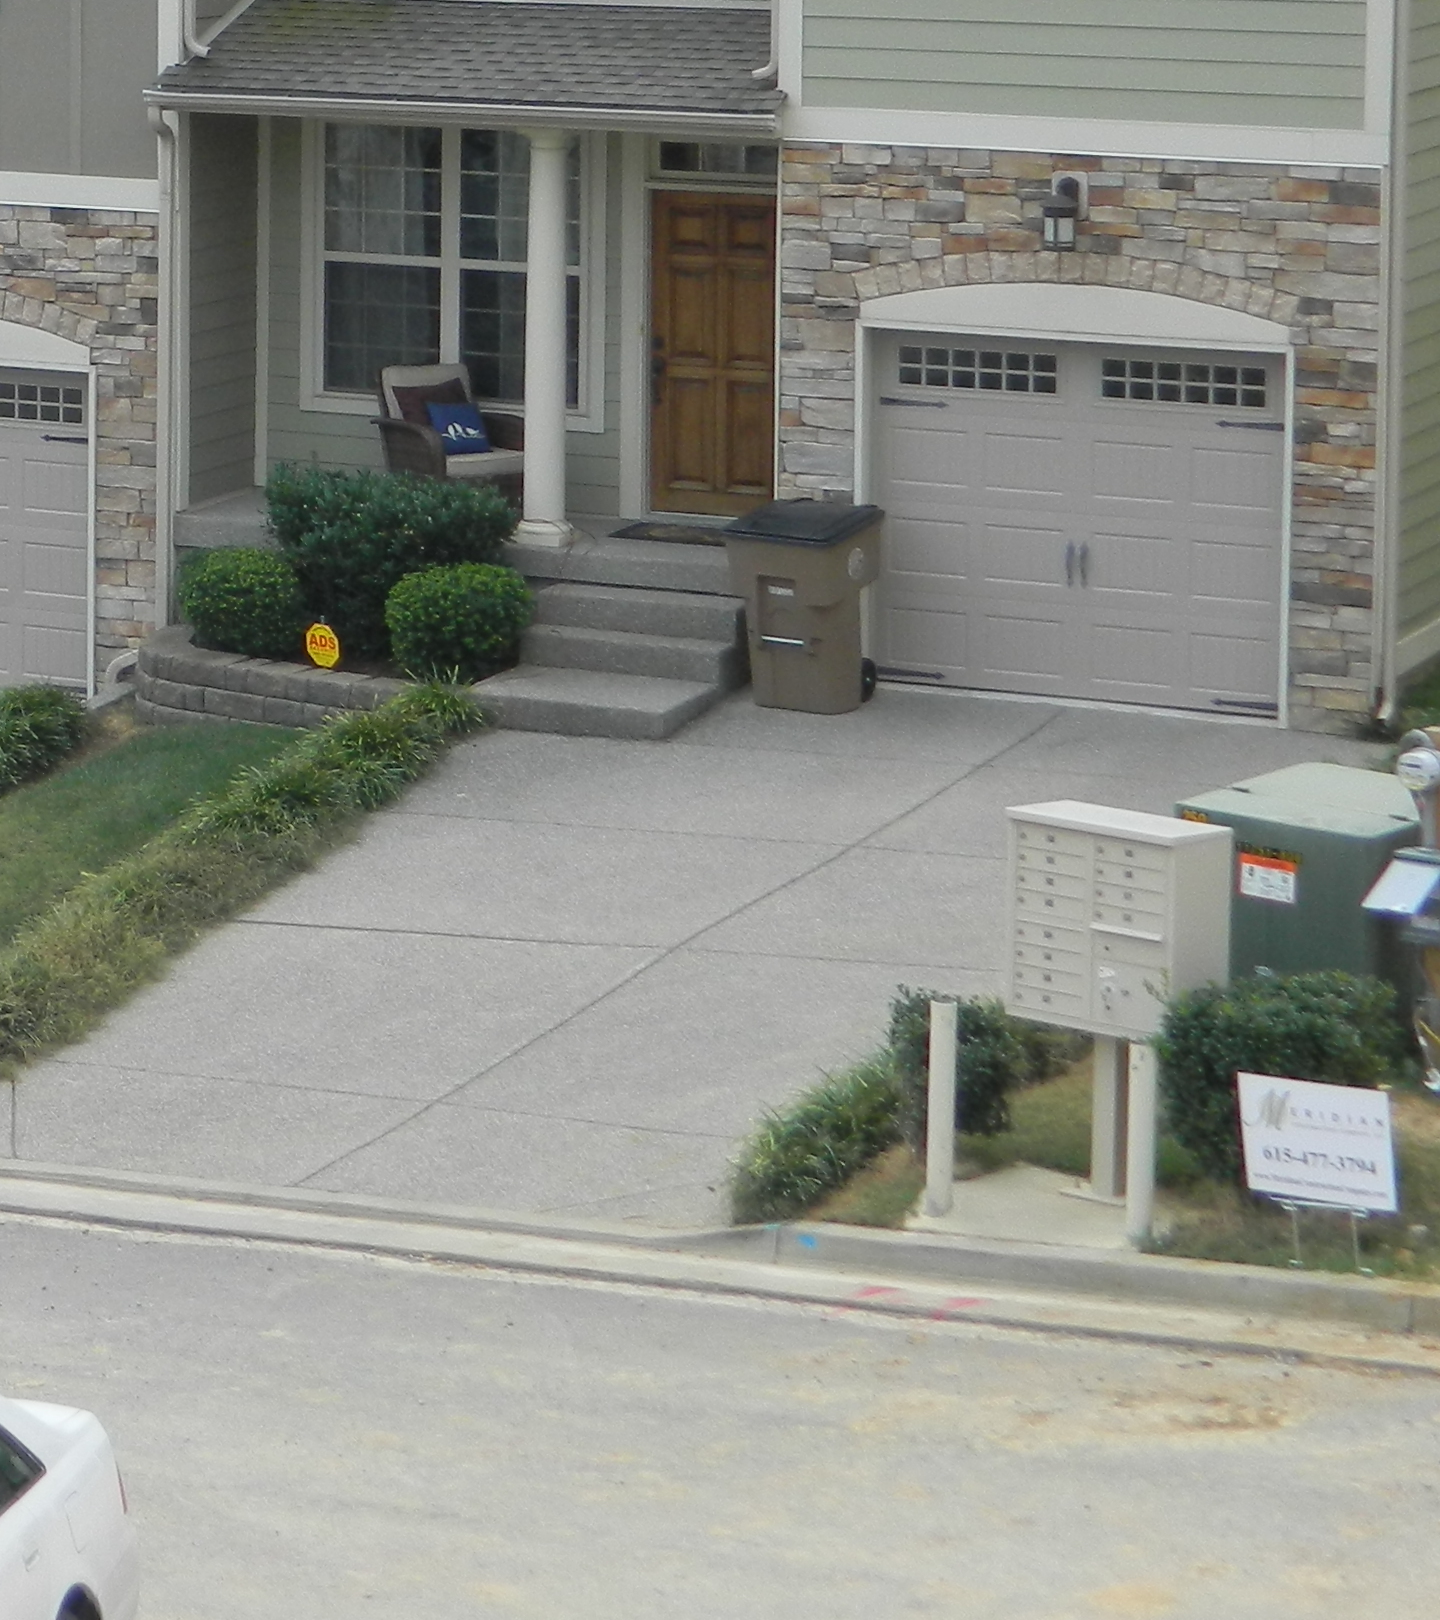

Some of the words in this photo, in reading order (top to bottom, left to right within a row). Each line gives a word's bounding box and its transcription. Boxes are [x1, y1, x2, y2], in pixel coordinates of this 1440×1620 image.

[309, 633, 337, 650] ADS
[1242, 1087, 1385, 1130] MERIDIAN
[1262, 1146, 1377, 1175] 615-477-3794
